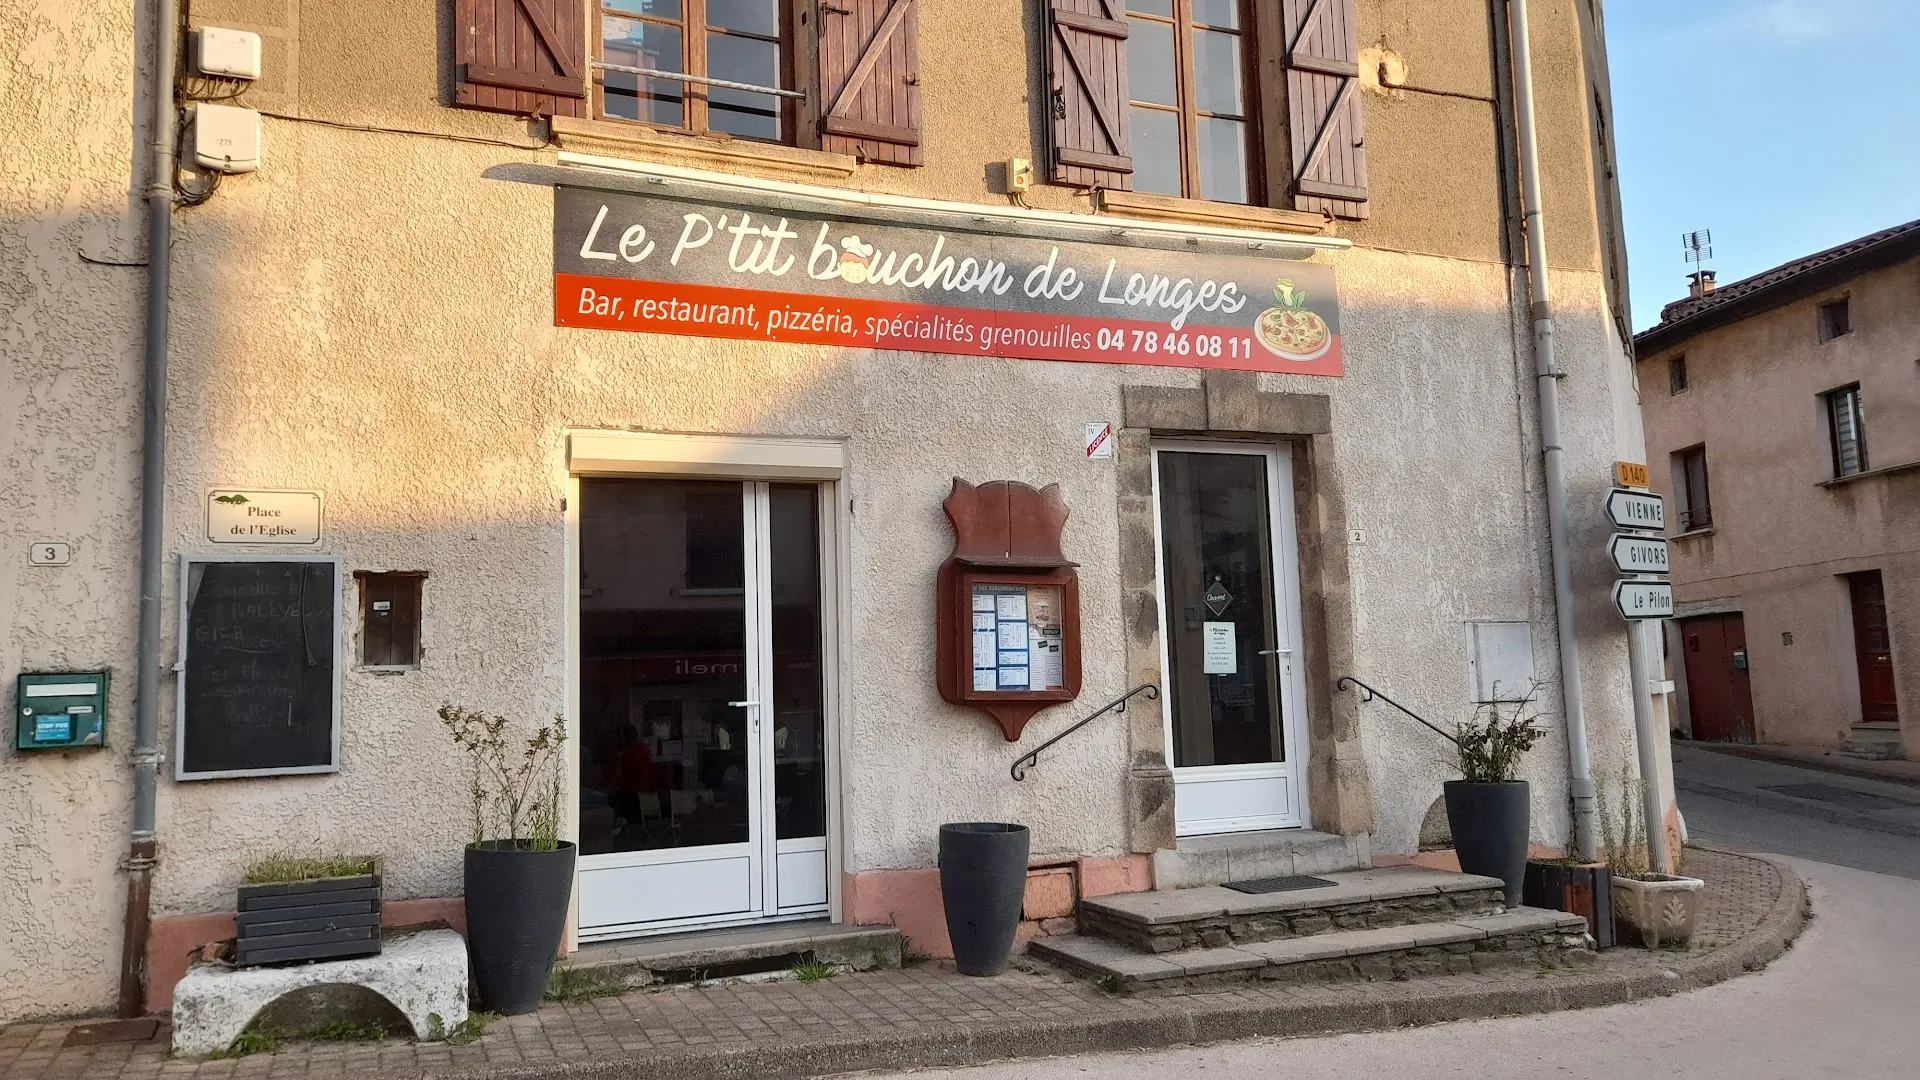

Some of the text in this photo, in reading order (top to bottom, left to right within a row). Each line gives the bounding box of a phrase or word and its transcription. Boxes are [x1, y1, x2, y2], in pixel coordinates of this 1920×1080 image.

[579, 204, 655, 262] Le
[670, 212, 798, 275] P'tit
[1023, 246, 1085, 301] de
[1097, 257, 1247, 331] Longes
[578, 287, 1252, 360] Bar, restaurant, pizzéria, spécialités grenouilles 04 78 46 08 11
[1622, 464, 1645, 484] D 140
[248, 506, 281, 517] Place
[1625, 500, 1662, 521] VIENNE
[230, 524, 297, 538] de l'Eglise
[1354, 531, 1361, 541] 2
[44, 547, 56, 561] 3
[1630, 546, 1666, 565] GIVORS
[1634, 591, 1670, 608] Le Pilon
